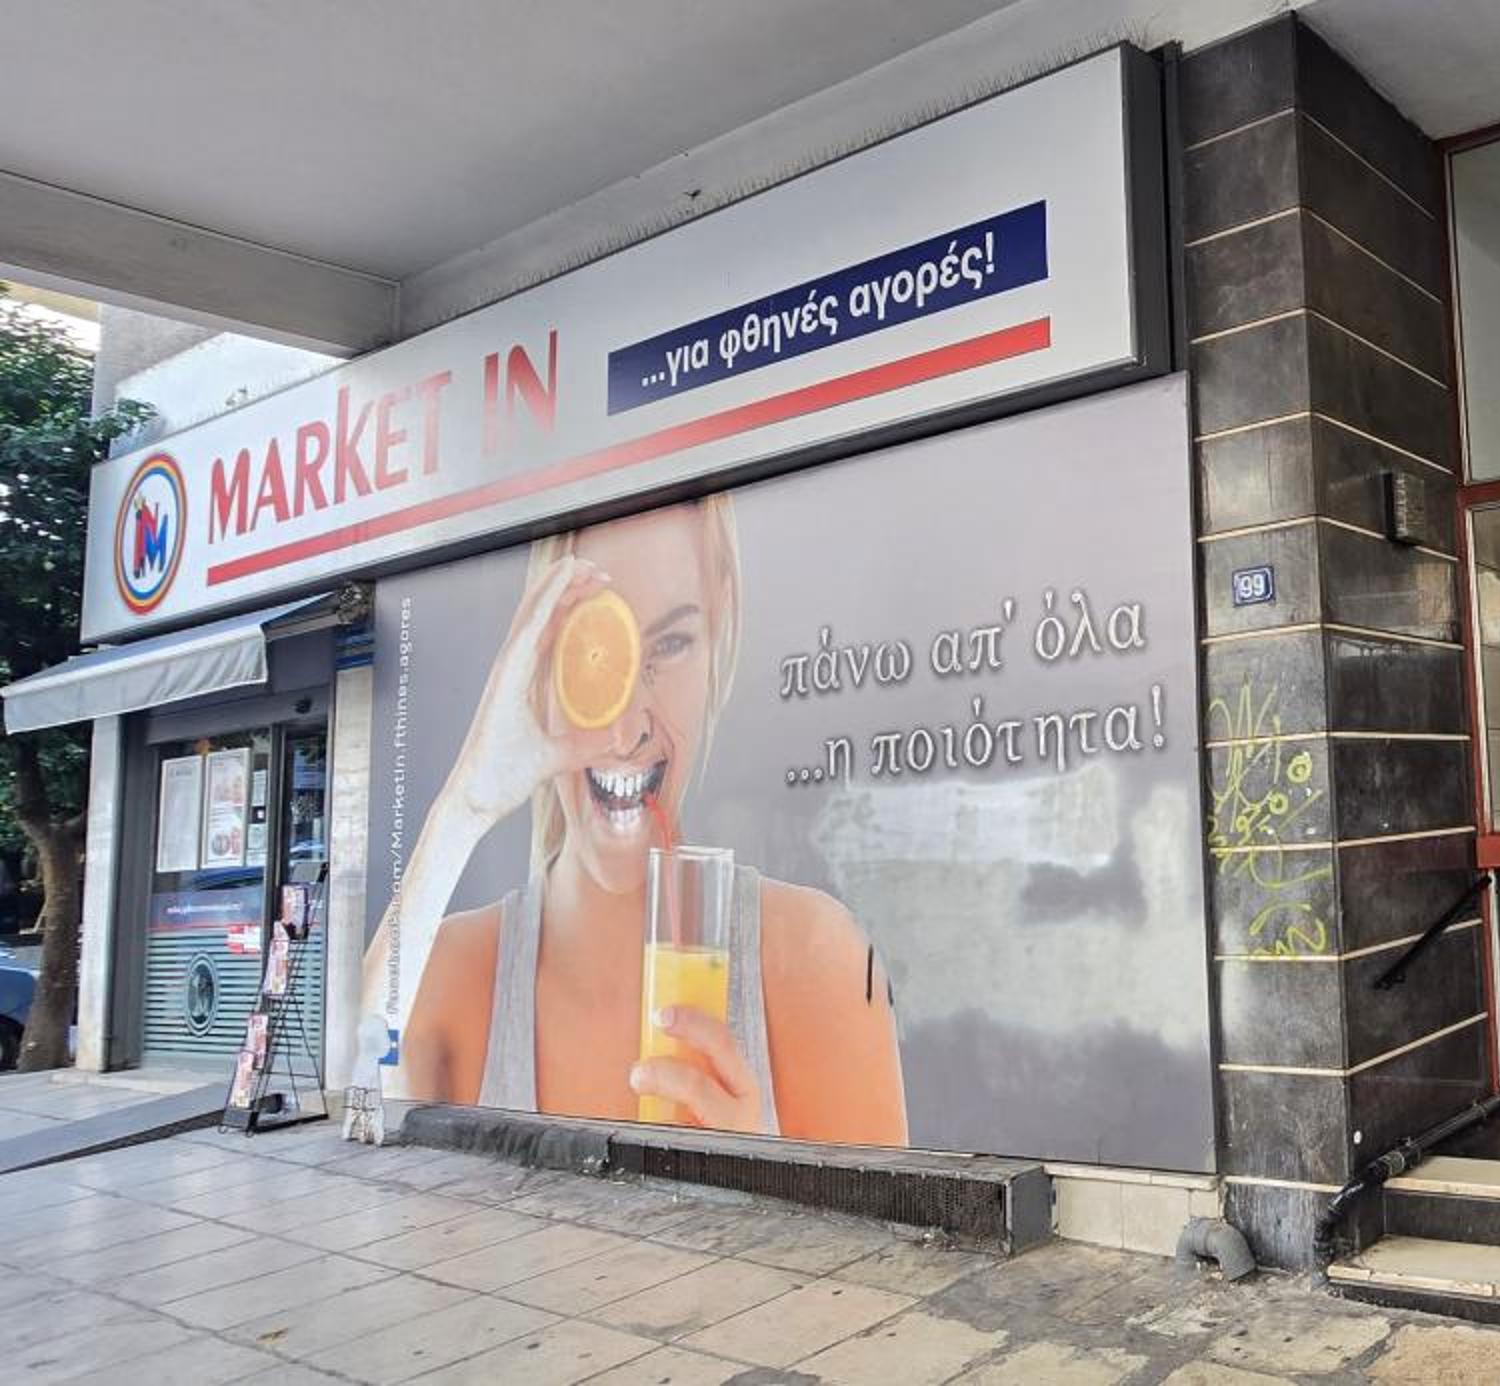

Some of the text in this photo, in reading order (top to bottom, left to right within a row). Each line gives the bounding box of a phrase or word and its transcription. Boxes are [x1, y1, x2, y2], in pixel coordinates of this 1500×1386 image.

[641, 232, 995, 386] ...για φθηνές αγορές!
[208, 327, 558, 544] MARKET IN
[1239, 574, 1265, 598] 99
[781, 627, 911, 697] πάνω
[1035, 591, 1145, 661] όλα
[786, 685, 1166, 790] ...η ποιότητα!
